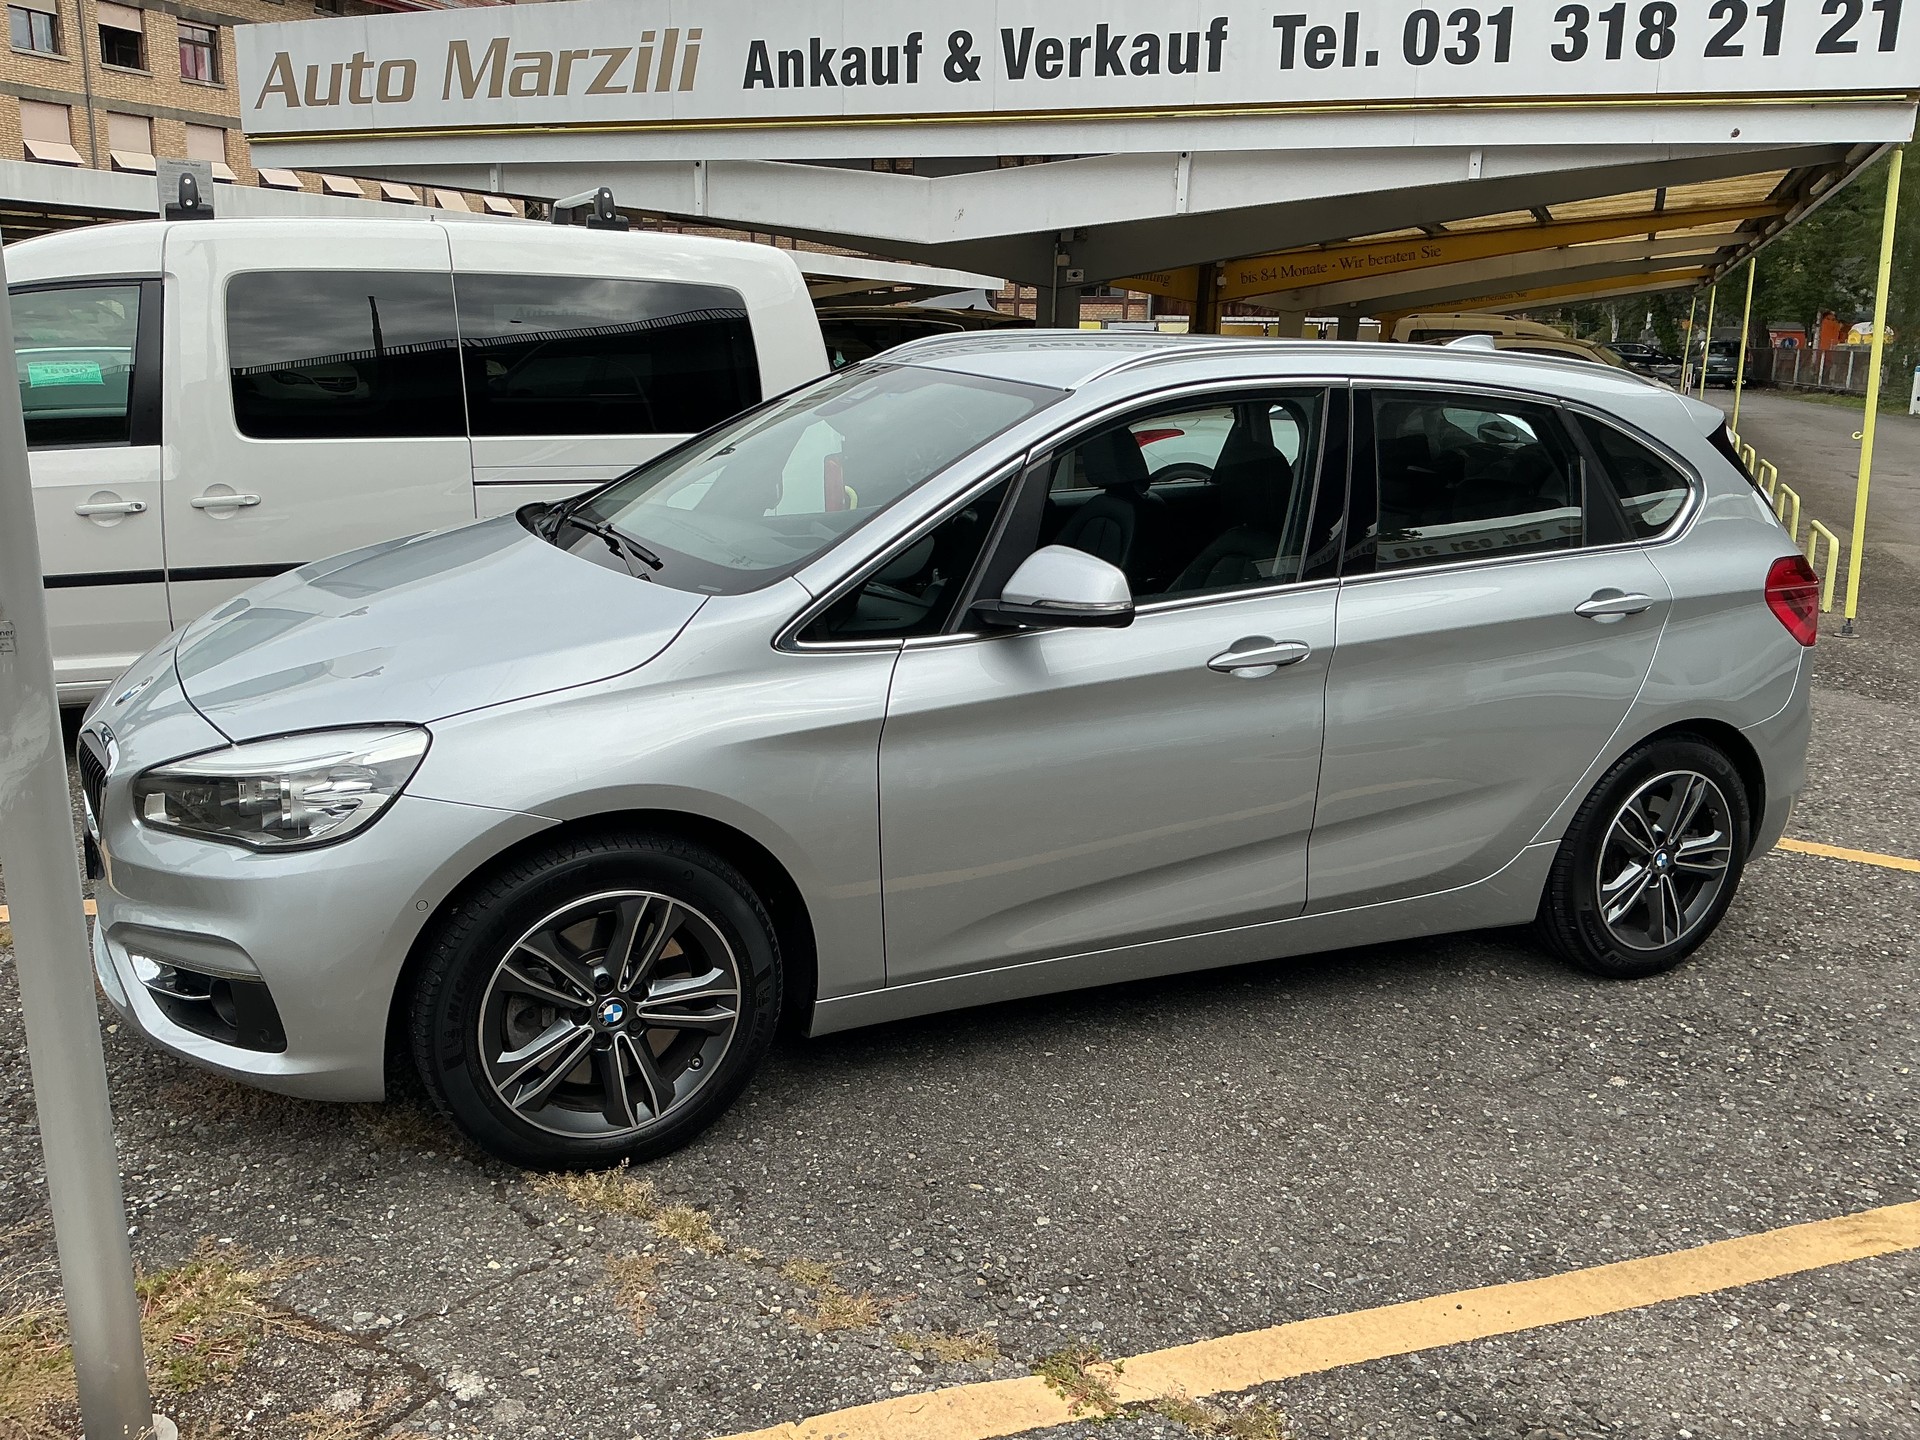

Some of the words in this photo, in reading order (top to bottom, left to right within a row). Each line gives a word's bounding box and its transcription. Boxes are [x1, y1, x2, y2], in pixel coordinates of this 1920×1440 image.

[254, 52, 417, 110] Auto
[442, 27, 704, 100] Marzili
[743, 31, 923, 89] Ankauf
[944, 30, 982, 83] &
[1000, 16, 1230, 81] Verkauf
[1273, 11, 1379, 70] Tel.
[1402, 6, 1515, 66] 031
[1551, 2, 1679, 62] 318
[1703, 0, 1788, 58] 21
[1814, 0, 1904, 55] 21
[1240, 270, 1258, 285] bis
[1260, 267, 1278, 282] 84
[1280, 262, 1329, 279] Monate
[1339, 256, 1365, 271] Wir
[1368, 249, 1417, 267] beraten
[1420, 244, 1442, 260] Sie
